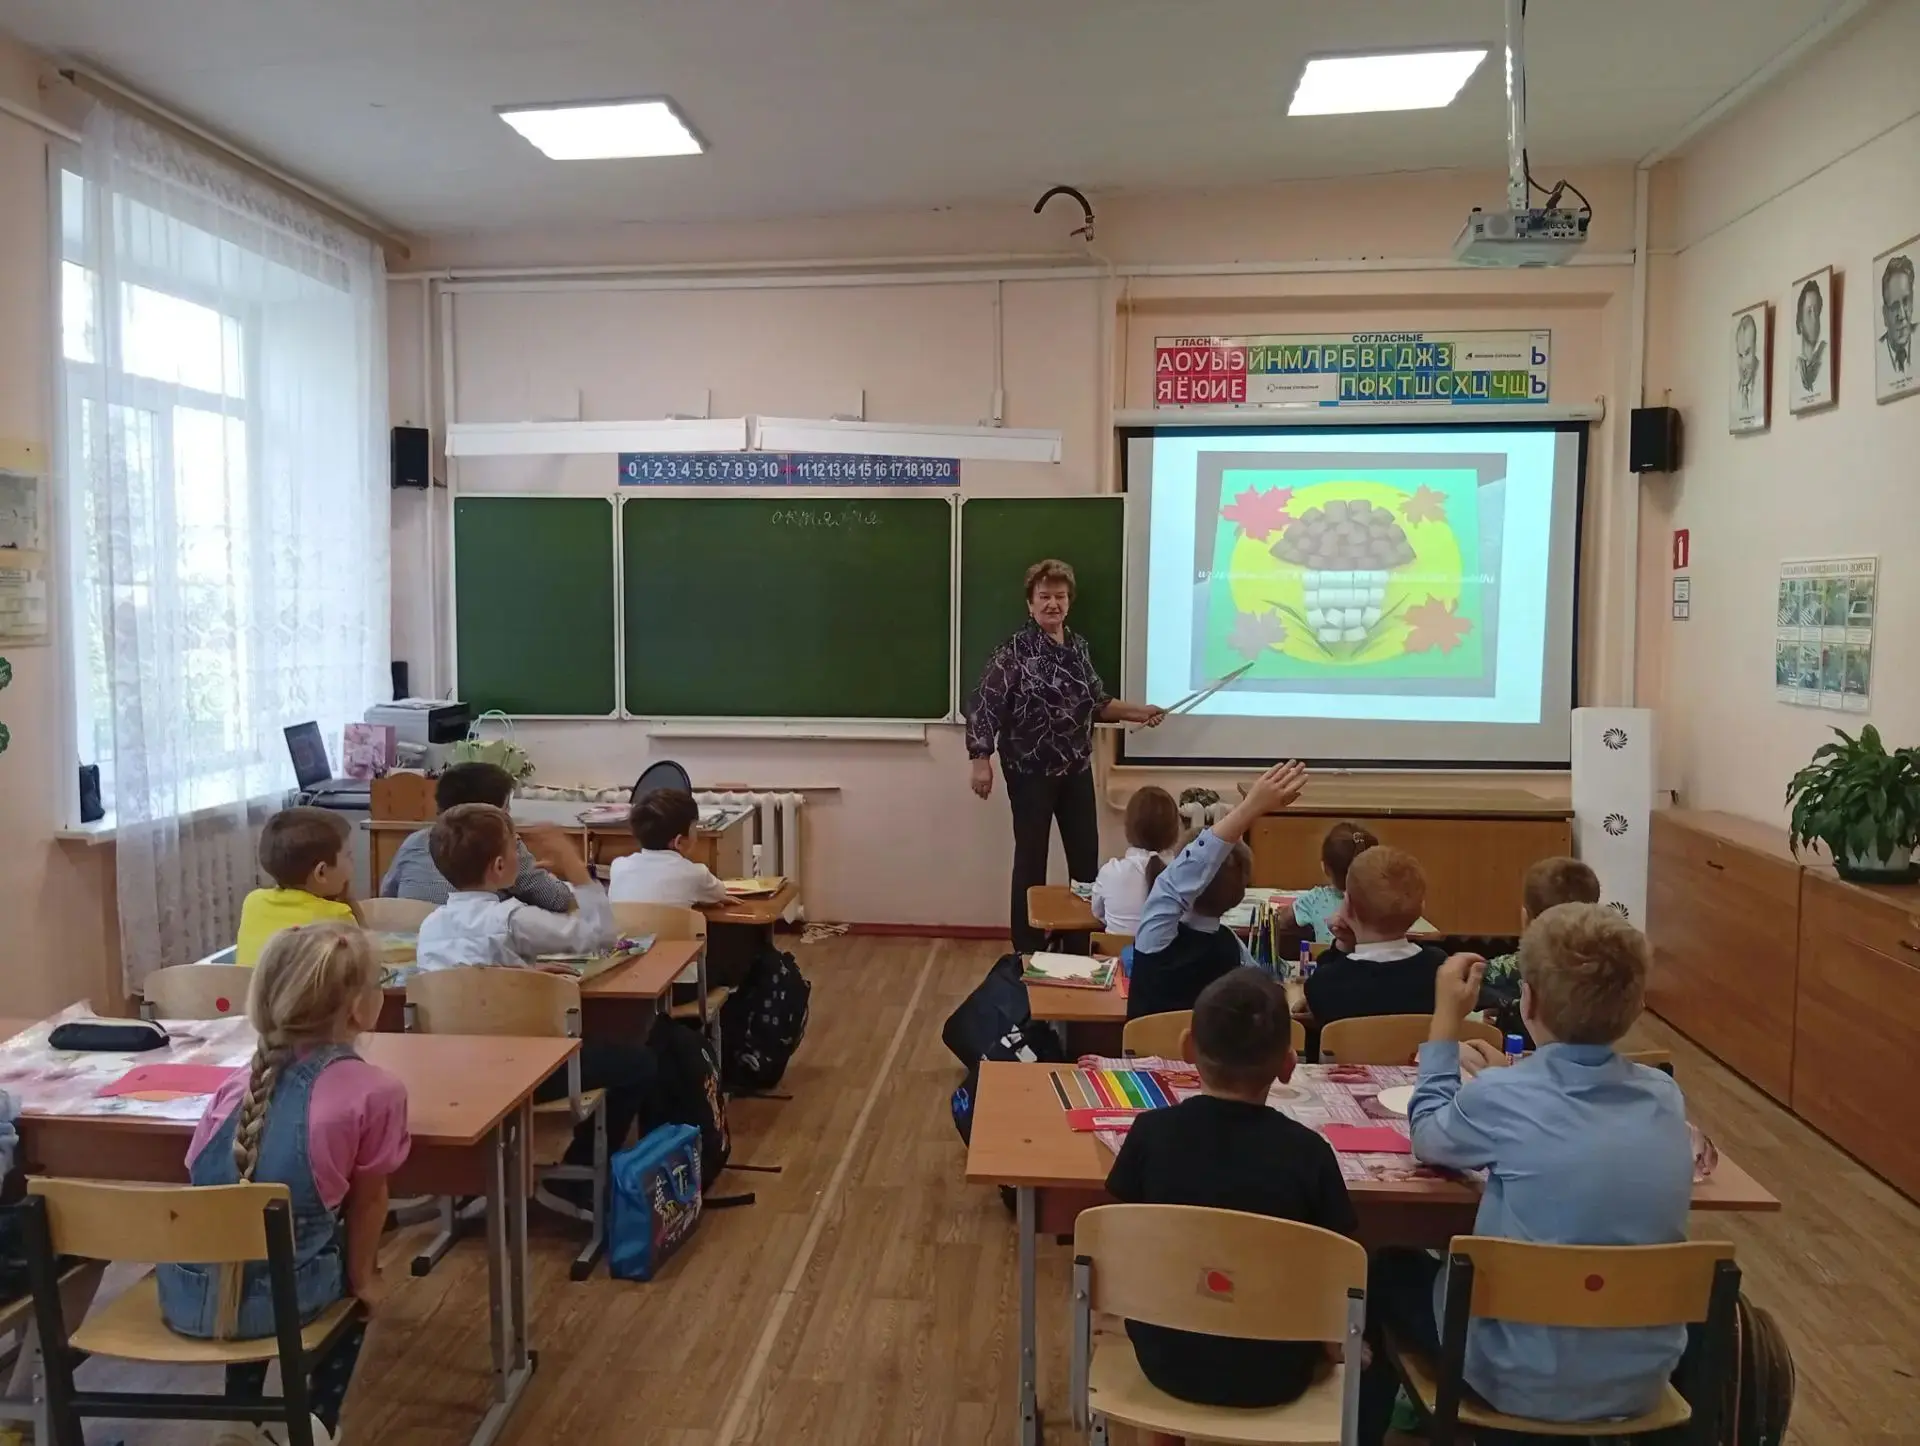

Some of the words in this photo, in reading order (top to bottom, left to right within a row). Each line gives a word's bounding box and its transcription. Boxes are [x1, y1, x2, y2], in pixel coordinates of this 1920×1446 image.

[1352, 333, 1423, 343] СОГЛАСНЫЕ
[628, 462, 637, 477] 0
[641, 462, 648, 477] 1
[654, 462, 663, 477] 2
[667, 462, 677, 477] 3
[680, 462, 690, 477] 4
[695, 462, 704, 477] 5
[708, 462, 717, 477] 6
[721, 462, 730, 477] 7
[734, 462, 743, 477] 8
[748, 462, 757, 477] 9
[762, 462, 779, 477] 10
